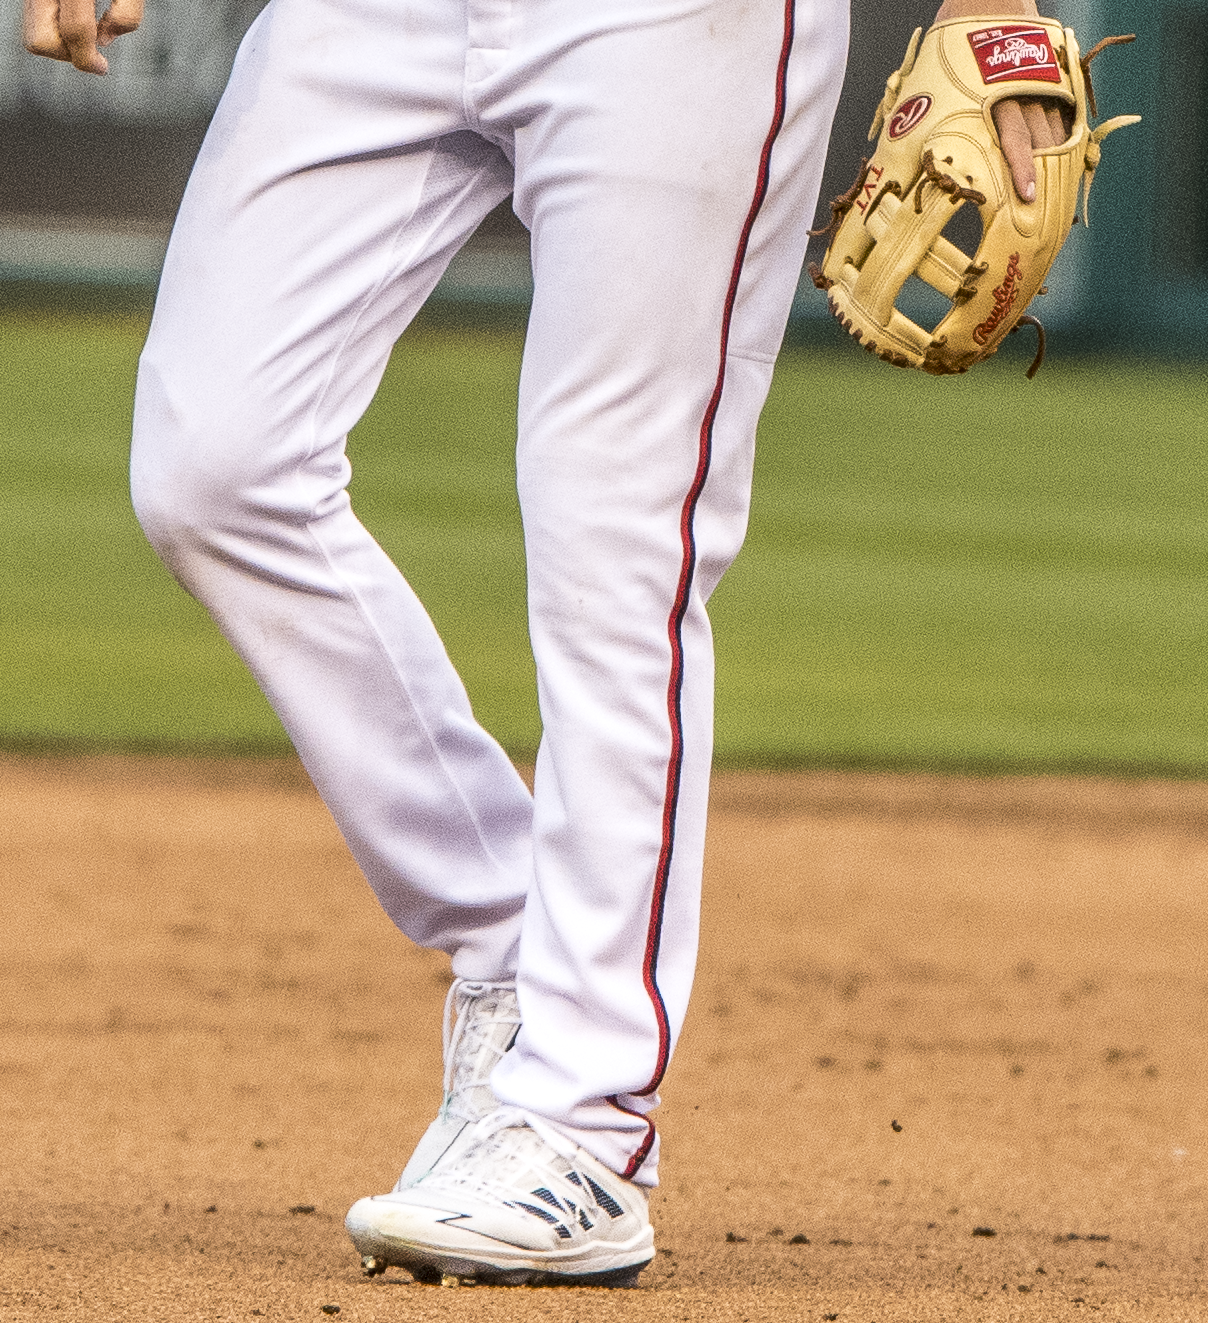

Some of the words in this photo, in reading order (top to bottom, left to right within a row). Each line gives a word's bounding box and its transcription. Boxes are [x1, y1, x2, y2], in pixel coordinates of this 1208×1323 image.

[985, 40, 1049, 67] Rawlings
[853, 165, 885, 216] TVT
[972, 251, 1024, 346] Rawlings
